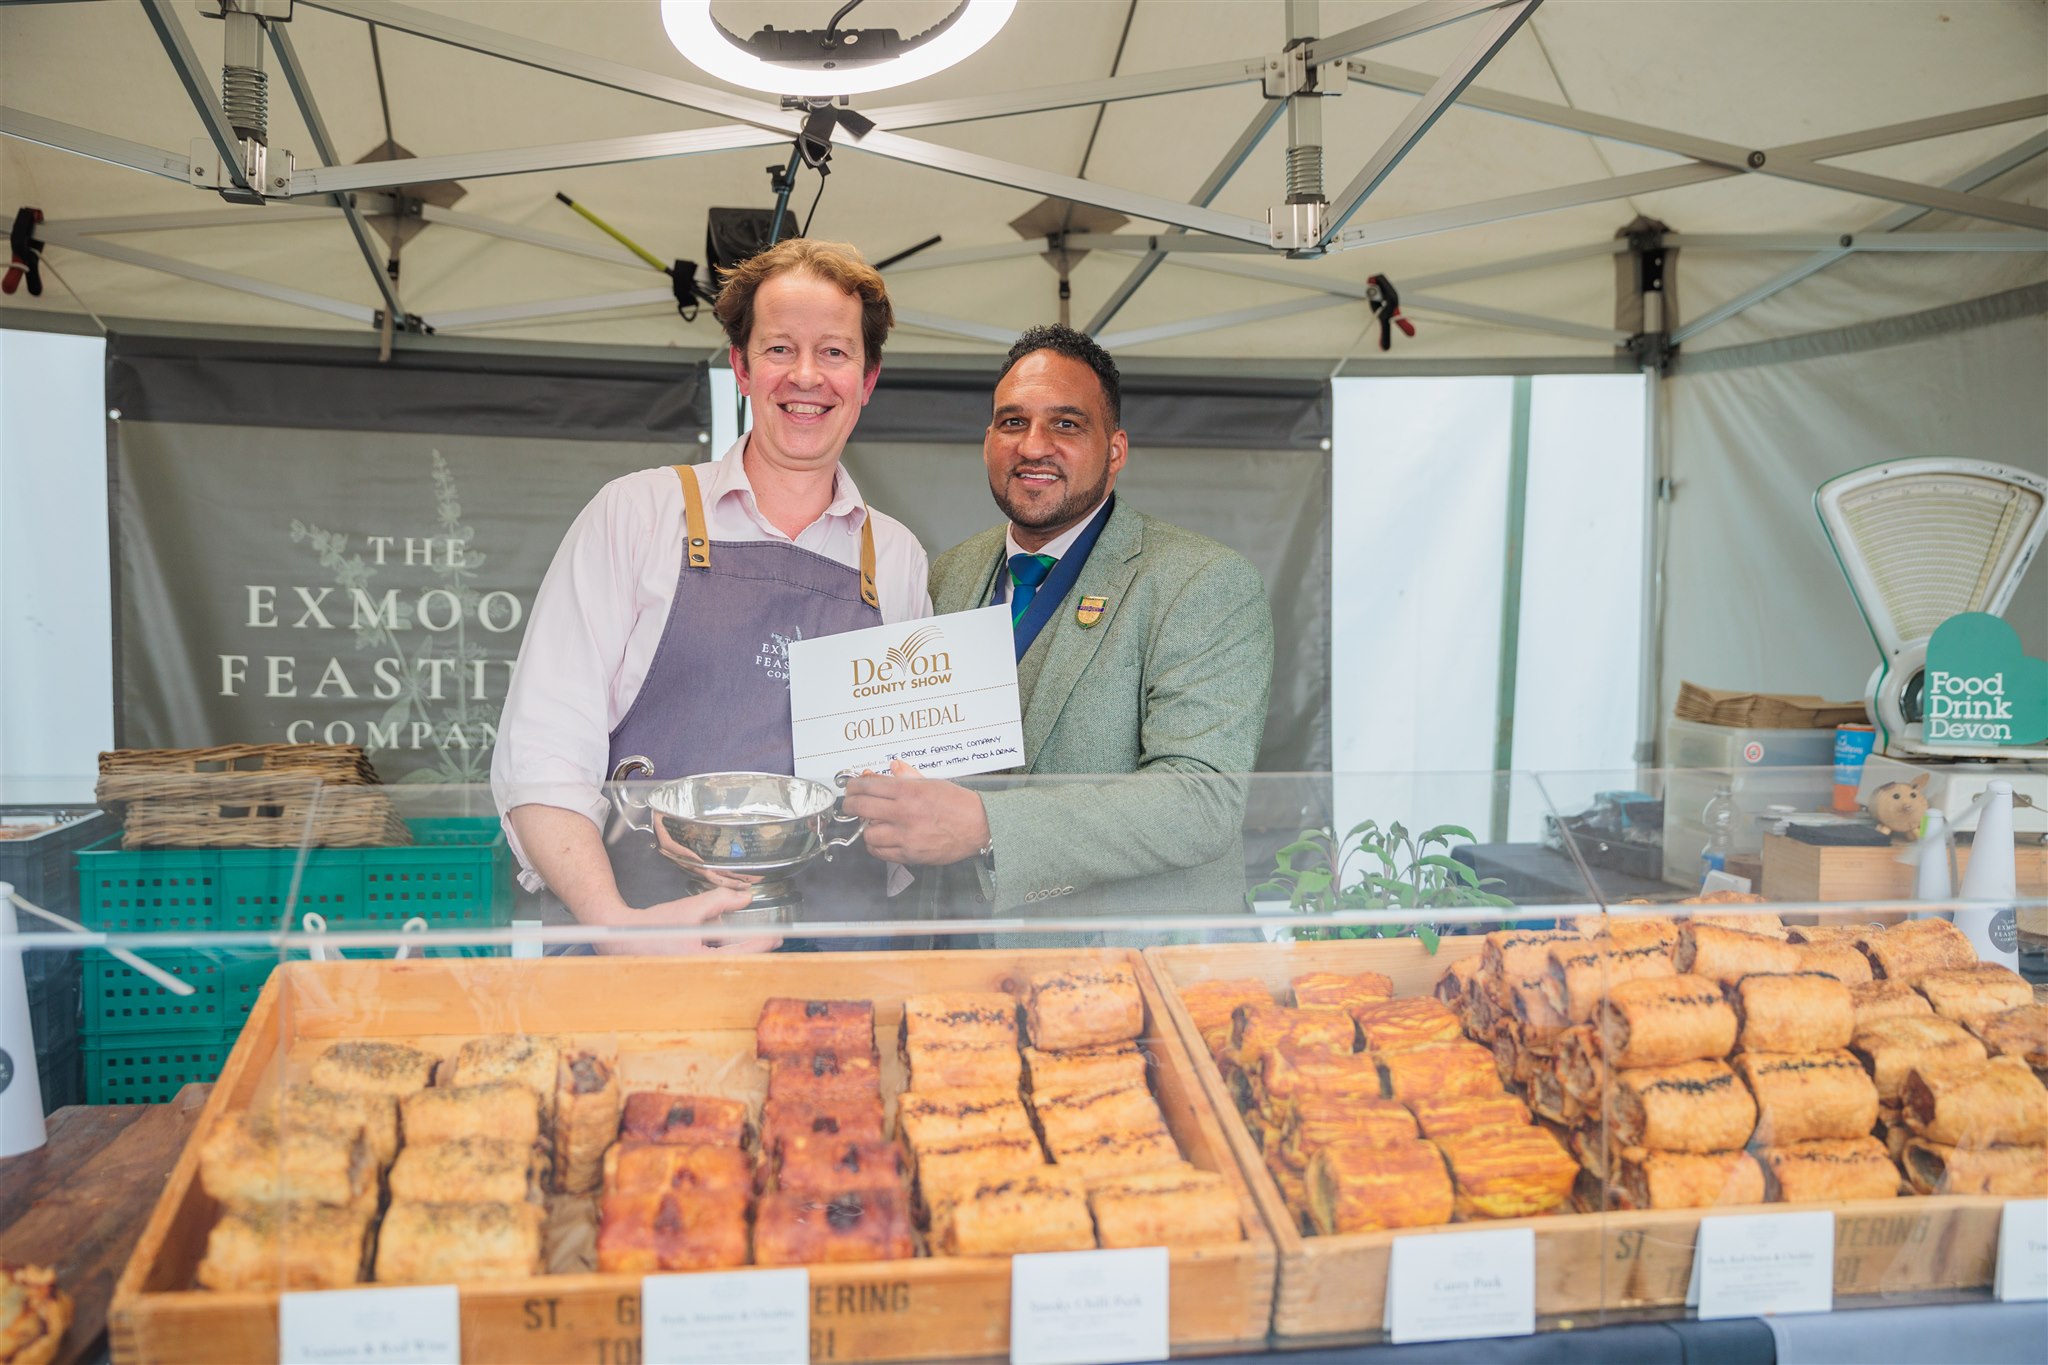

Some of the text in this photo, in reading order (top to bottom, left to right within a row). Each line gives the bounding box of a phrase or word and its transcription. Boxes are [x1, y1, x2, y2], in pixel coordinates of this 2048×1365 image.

[367, 536, 466, 567] THE
[245, 585, 522, 633] EXMOO
[853, 673, 952, 698] COUNTY SHOW
[1930, 671, 2005, 695] Food
[1929, 695, 2013, 719] Drink
[844, 704, 965, 742] GOLD MEDAL
[1929, 719, 2013, 739] Devon
[967, 735, 1001, 748] COMPANY
[524, 1298, 574, 1331] ST.
[810, 1281, 910, 1315] ERING
